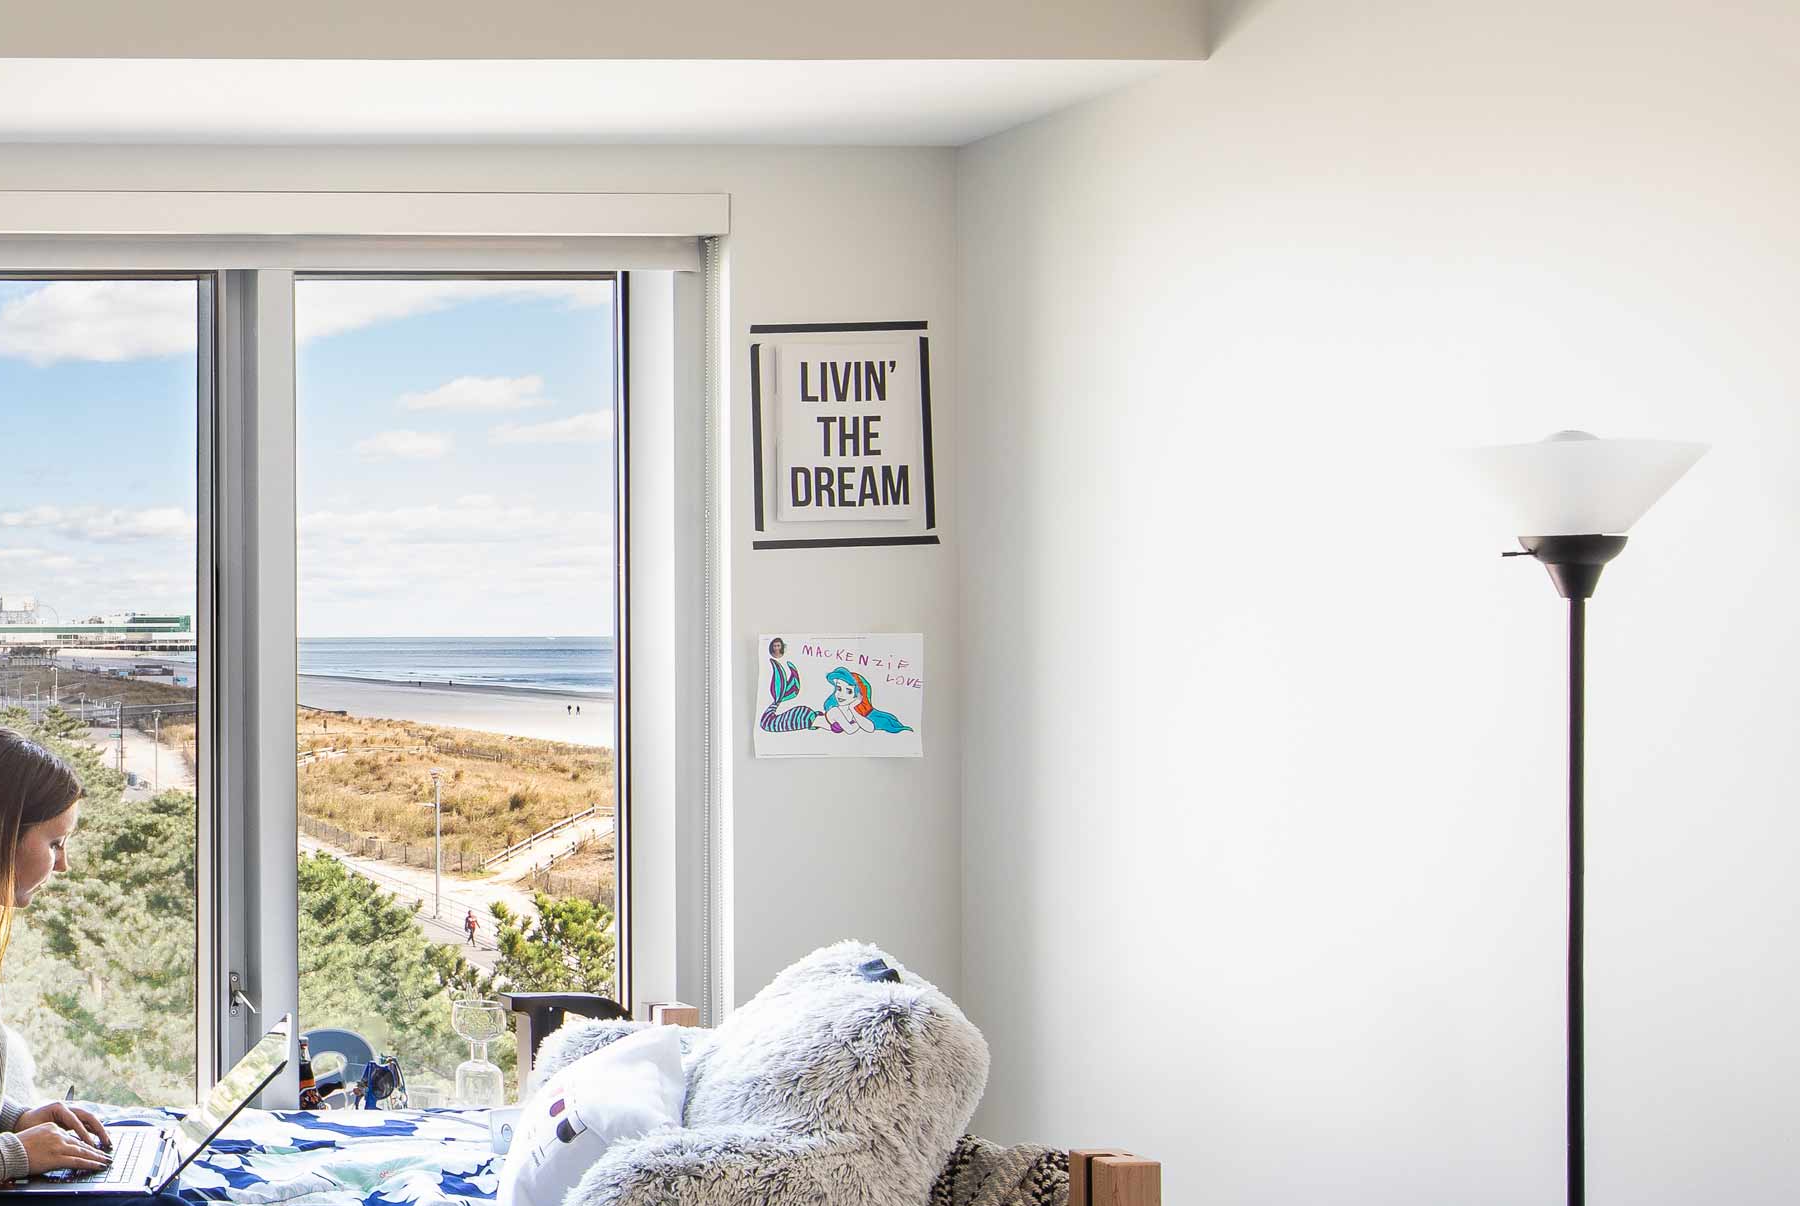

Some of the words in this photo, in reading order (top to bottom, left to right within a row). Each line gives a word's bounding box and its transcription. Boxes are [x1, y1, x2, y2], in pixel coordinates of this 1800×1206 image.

[800, 360, 897, 403] LIVIN'
[816, 415, 882, 457] THE
[790, 464, 911, 508] DREAM
[885, 673, 924, 689] LOVE
